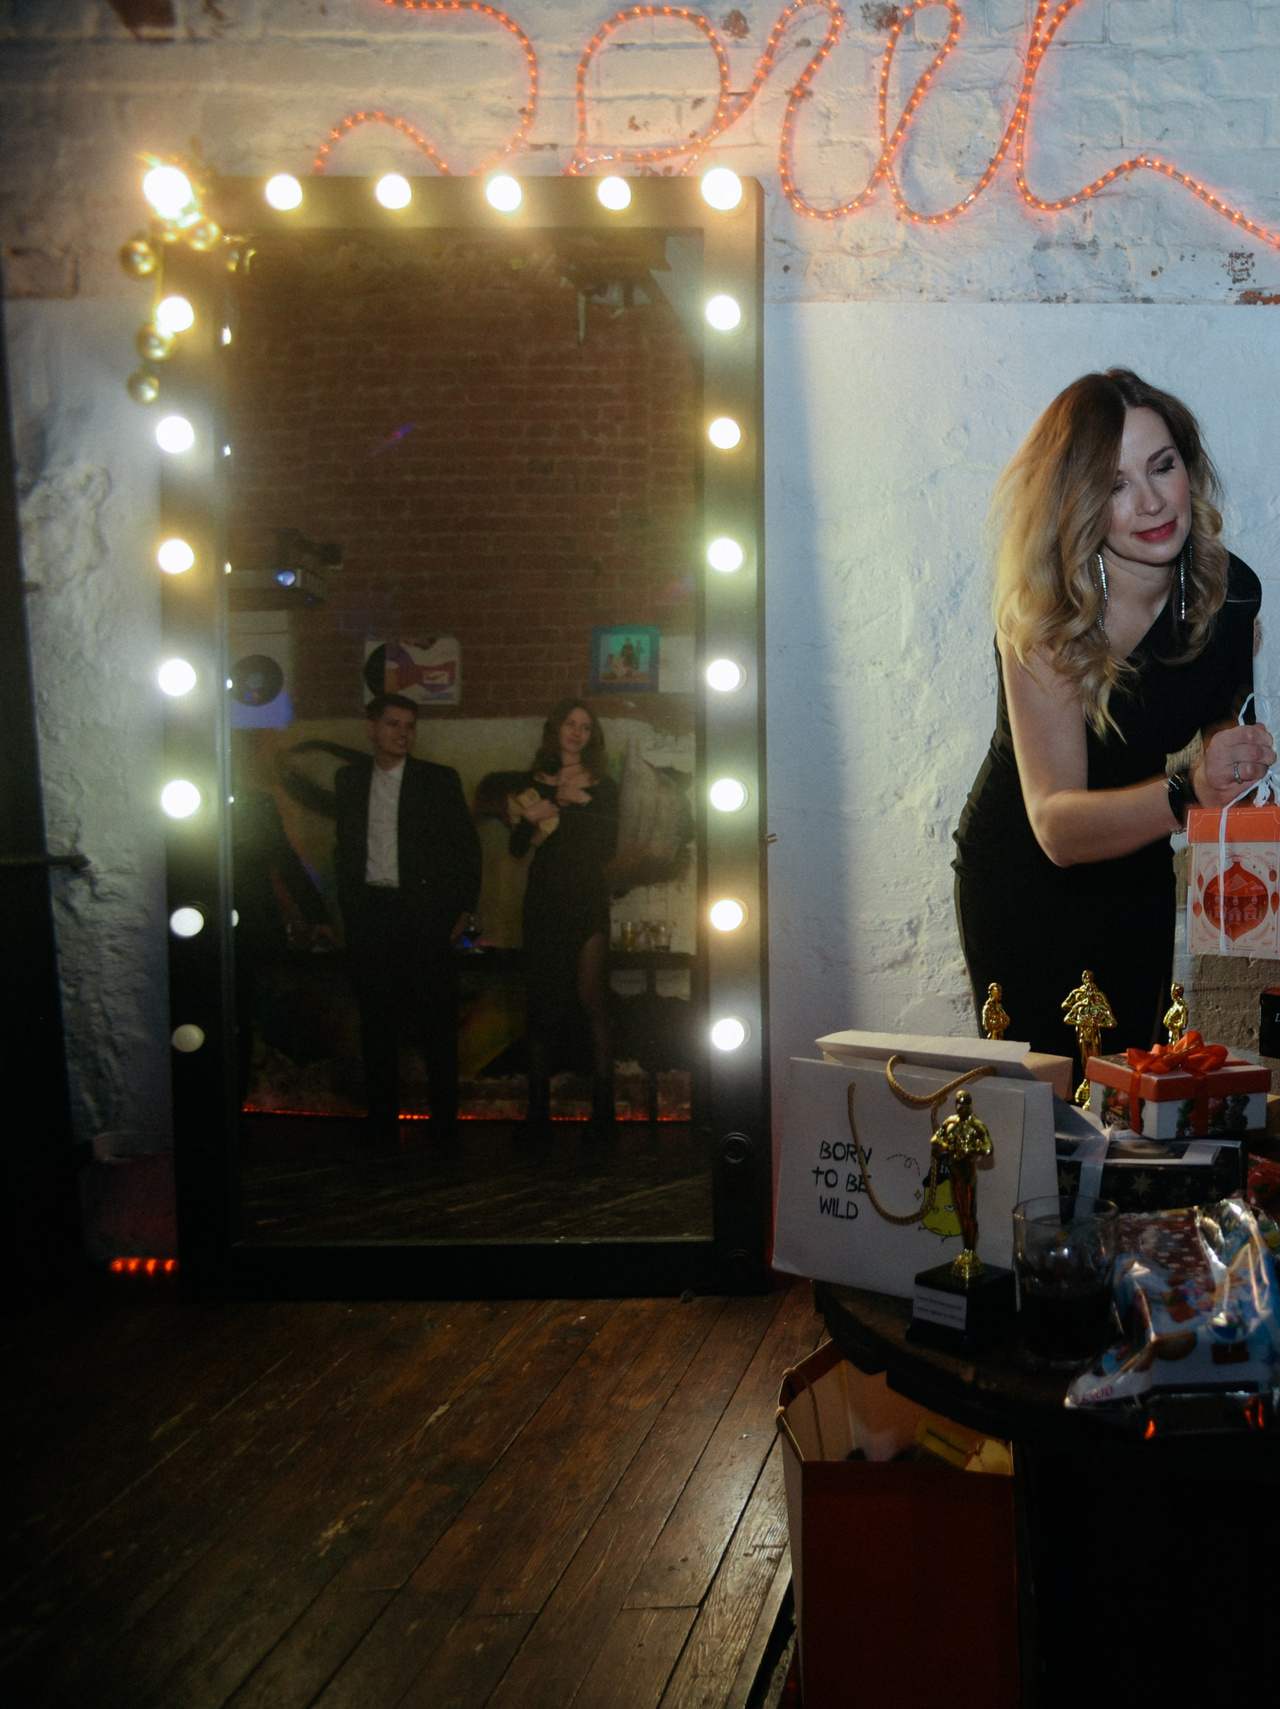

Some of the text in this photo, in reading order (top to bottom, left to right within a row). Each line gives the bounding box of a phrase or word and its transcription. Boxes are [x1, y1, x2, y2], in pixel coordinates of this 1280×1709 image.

[819, 1140, 873, 1165] BORN
[846, 1173, 872, 1194] BE
[819, 1196, 859, 1220] WILD
